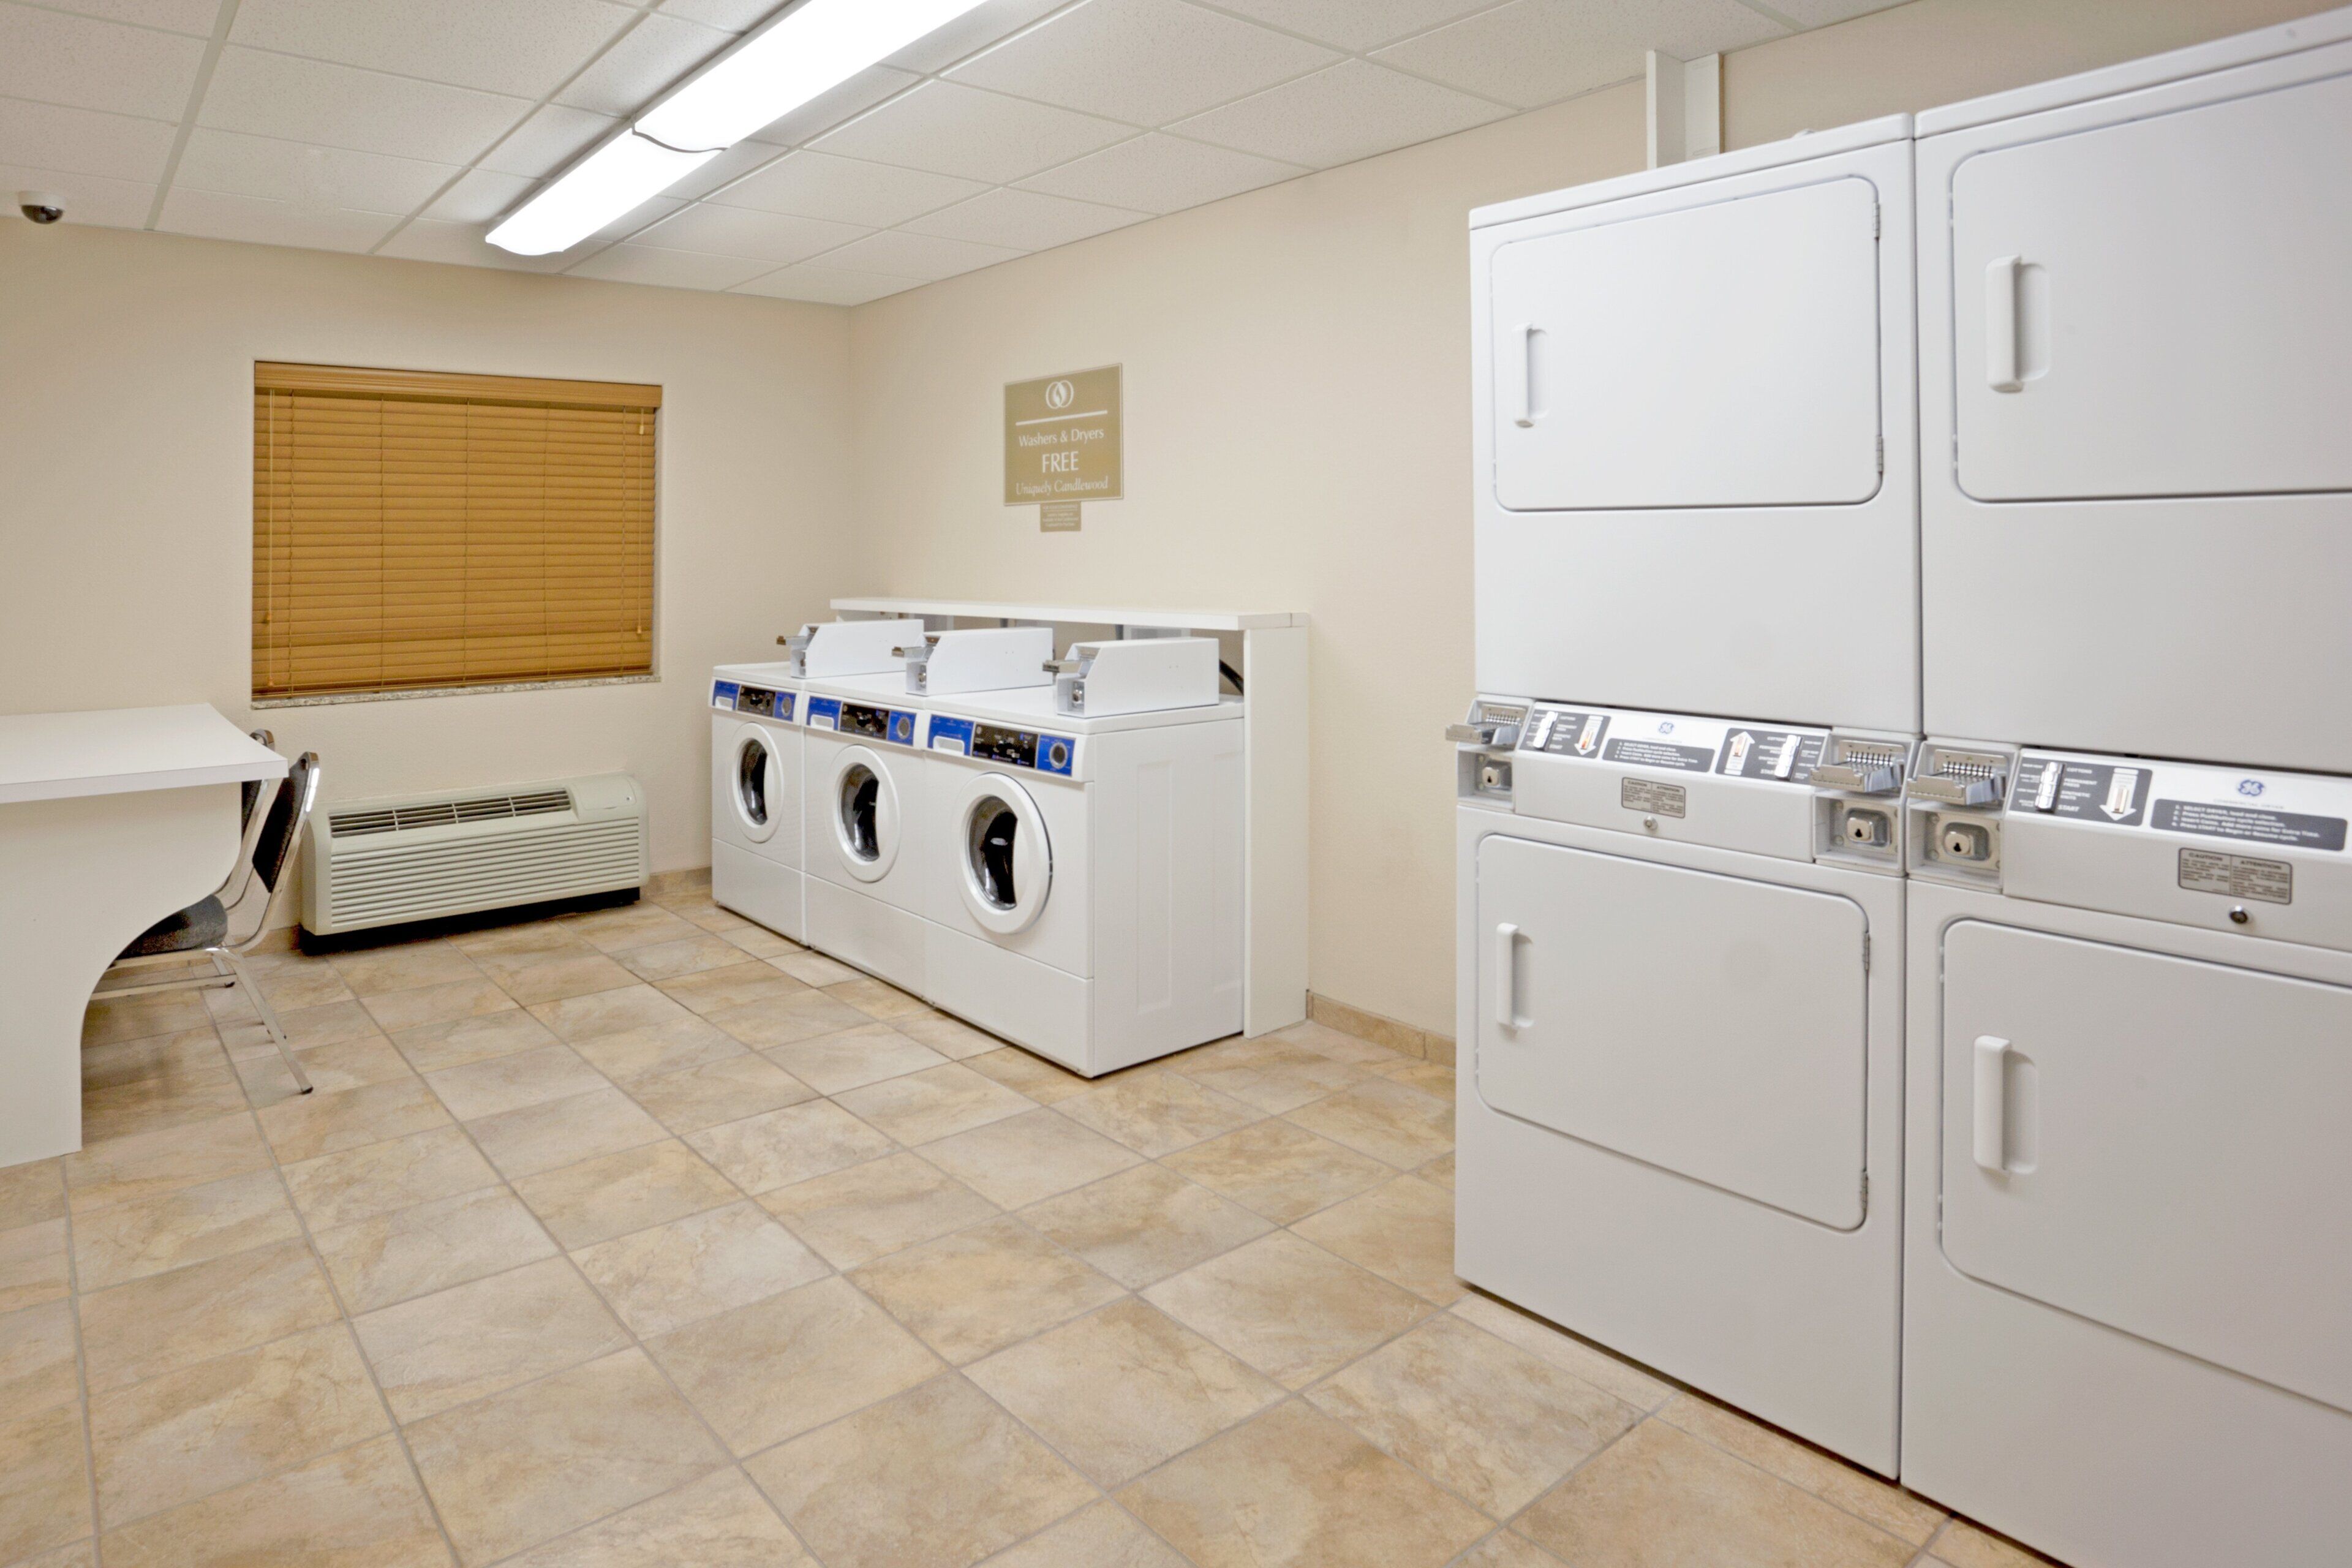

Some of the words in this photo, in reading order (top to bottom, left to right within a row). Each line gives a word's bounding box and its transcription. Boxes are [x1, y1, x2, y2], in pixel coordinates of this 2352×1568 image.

[1019, 431, 1057, 447] Washers
[1060, 431, 1068, 443] &
[1071, 428, 1104, 444] Dryers
[1042, 451, 1079, 473] FREE
[1016, 480, 1052, 496] Uniquely
[1054, 475, 1109, 493] Candlewood
